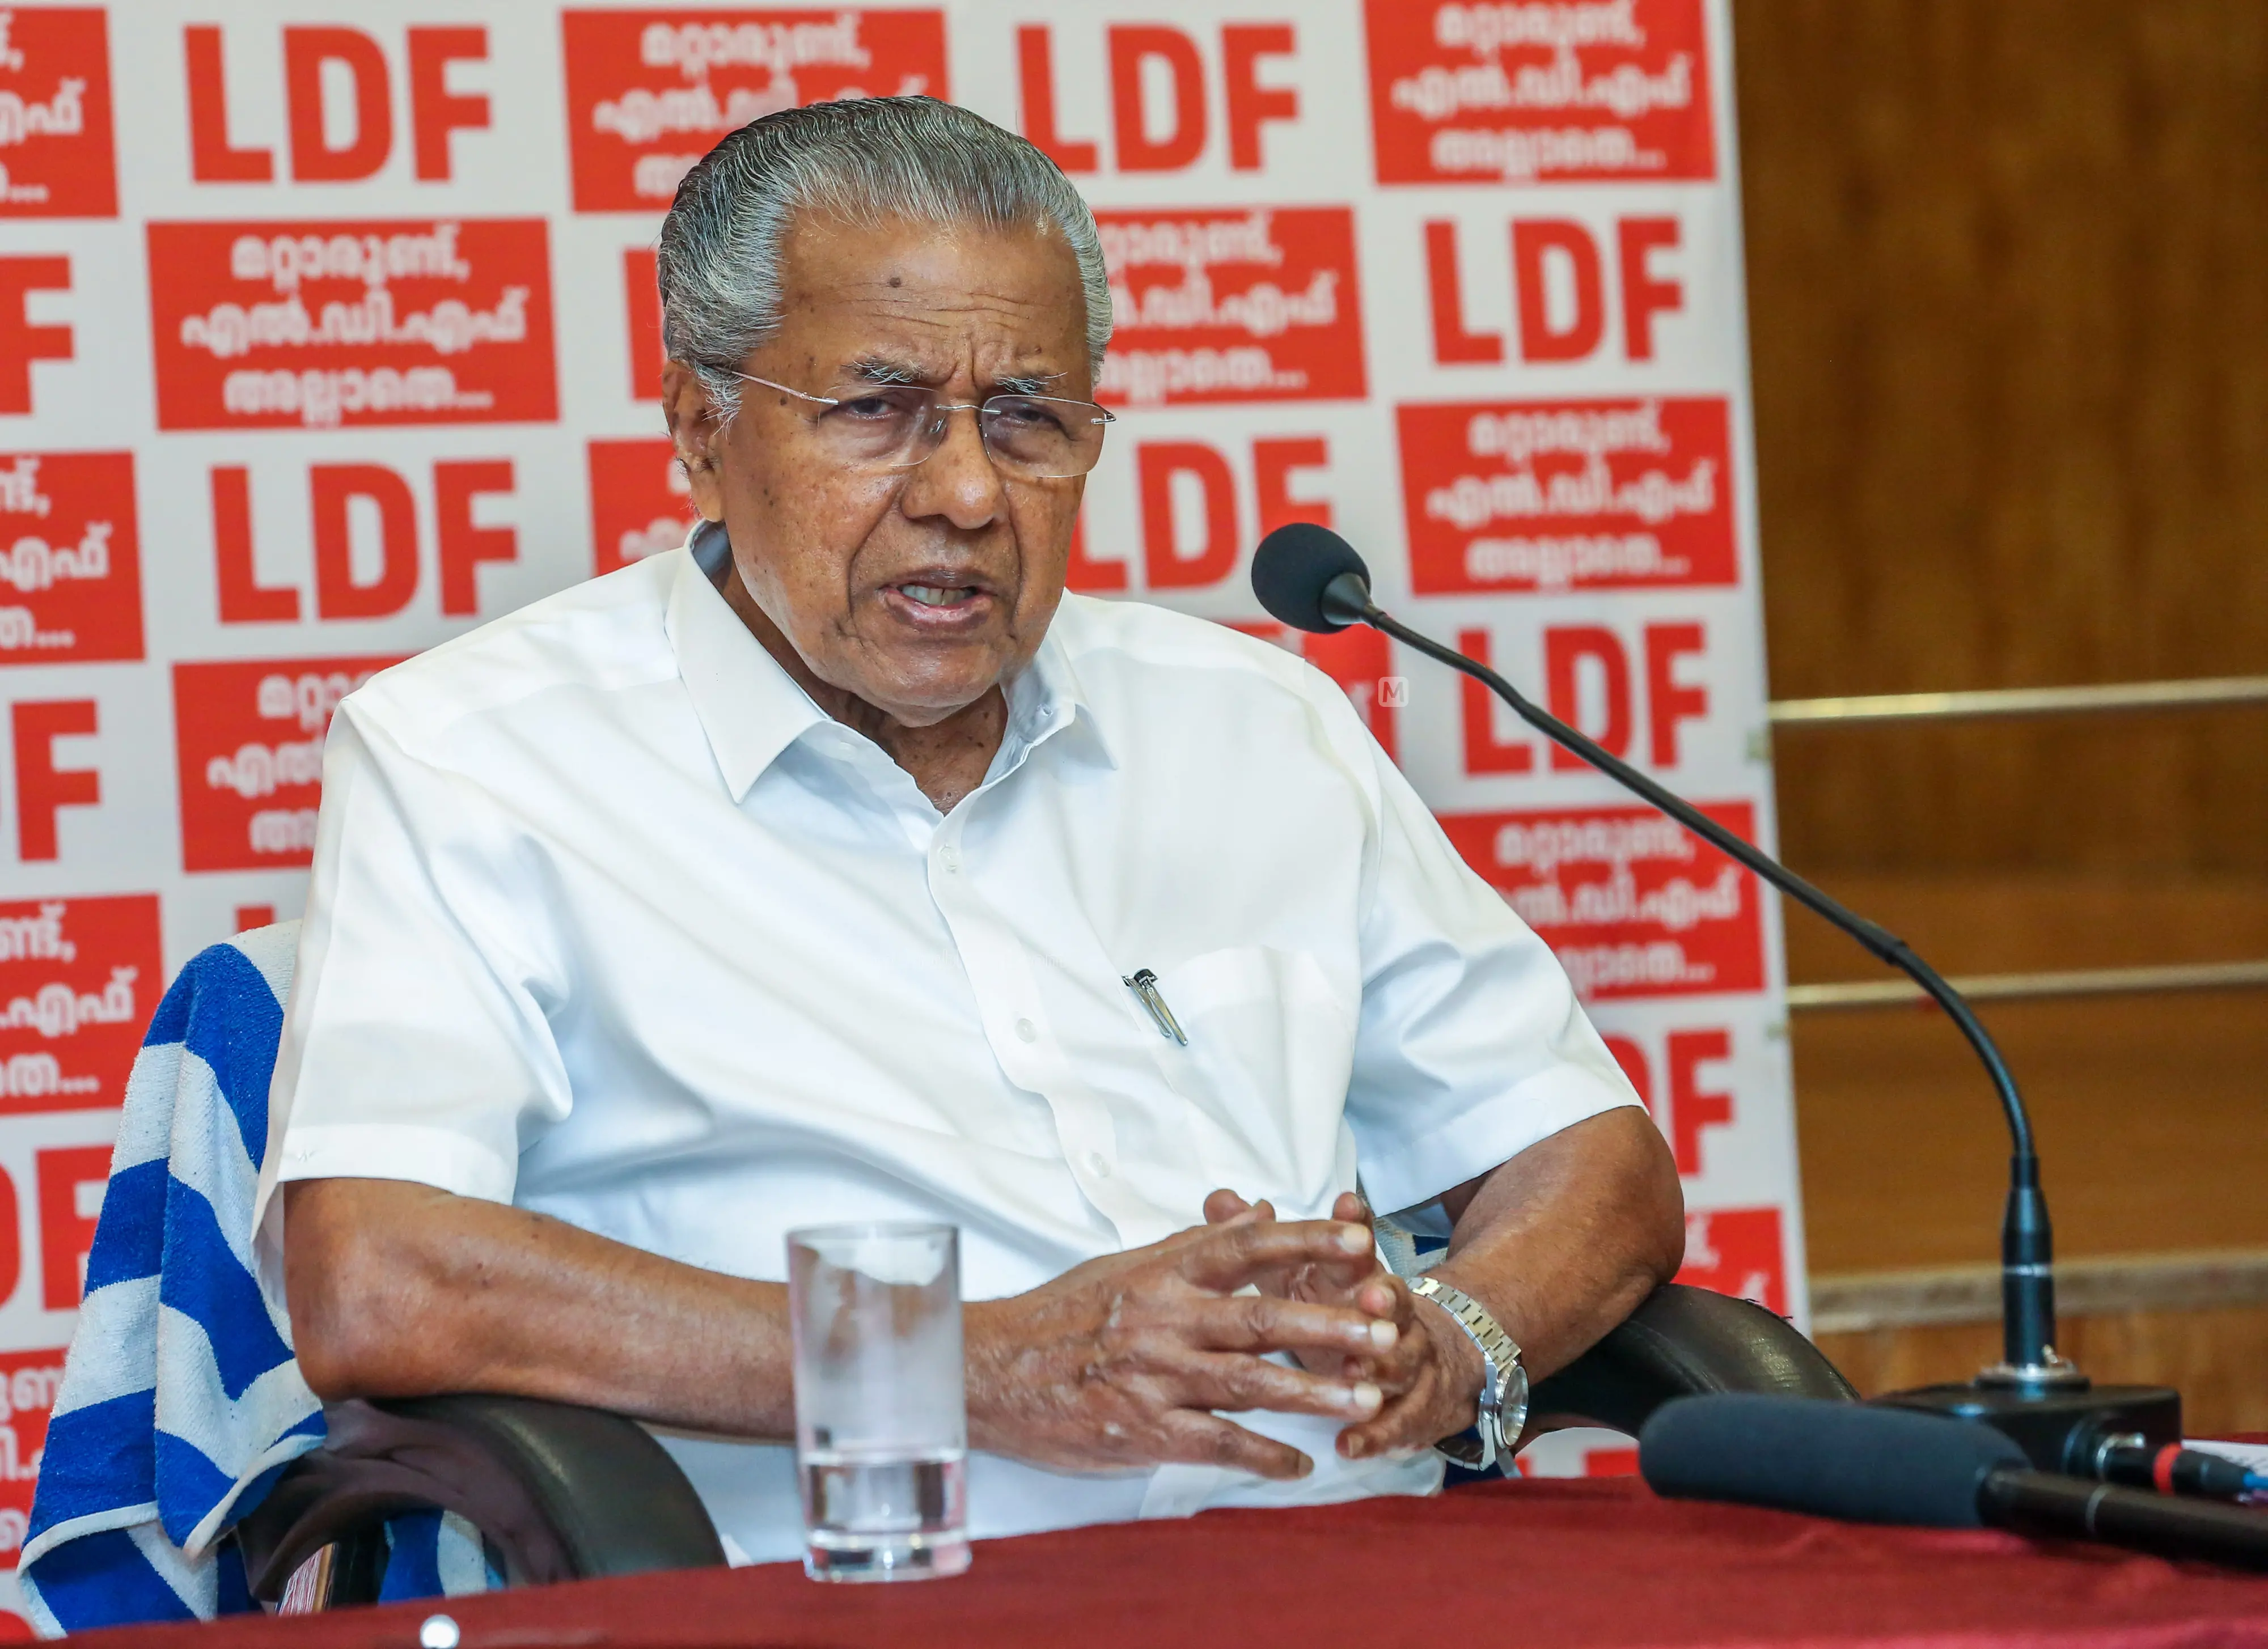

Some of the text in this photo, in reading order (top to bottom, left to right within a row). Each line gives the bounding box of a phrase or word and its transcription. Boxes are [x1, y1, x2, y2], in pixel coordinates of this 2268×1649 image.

[183, 24, 491, 184] LDF
[1014, 20, 1302, 175] LDF
[1423, 213, 1685, 367] LDF
[209, 459, 520, 626] LDF
[1458, 620, 1709, 778] LDF
